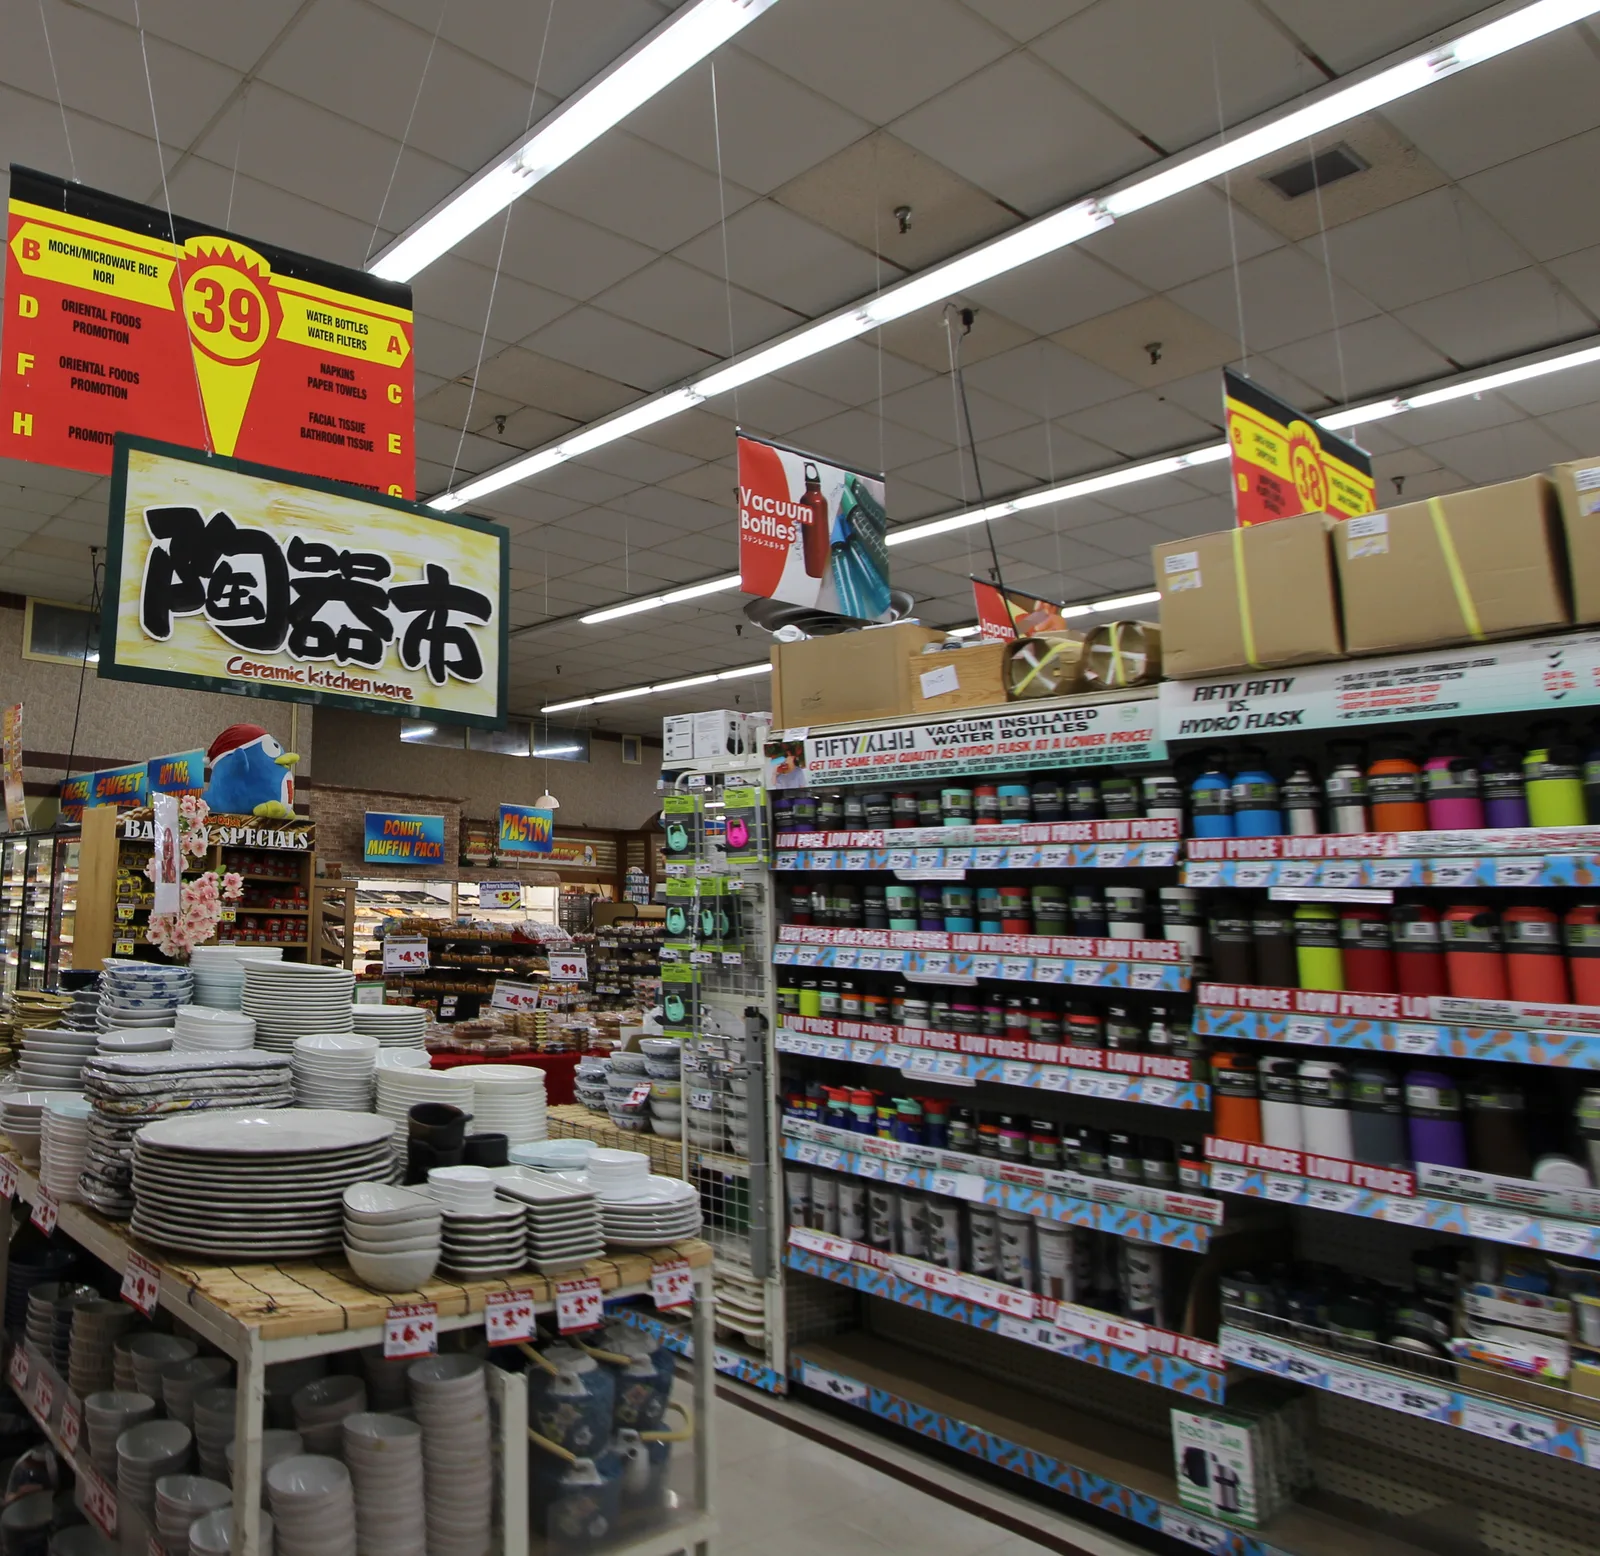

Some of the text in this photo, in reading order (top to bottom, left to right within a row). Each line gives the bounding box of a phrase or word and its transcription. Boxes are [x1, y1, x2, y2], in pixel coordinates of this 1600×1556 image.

[22, 238, 41, 261] B
[48, 239, 158, 279] MOCHI/MICROWAVE RICE
[92, 269, 115, 285] NORI
[18, 294, 39, 319] D
[61, 299, 142, 330] ORIENTAL FOODS
[193, 277, 261, 343] 39
[72, 319, 130, 346] PROMOTION
[306, 309, 369, 336] WATER BOTTLES
[307, 326, 367, 352] WATER FILTERS
[387, 336, 402, 355] A
[17, 352, 35, 375] F
[59, 355, 140, 385] ORIENTAL FOODS
[320, 362, 356, 382] NAPKINS
[70, 375, 128, 401] PROMOTION
[307, 376, 367, 400] PAPER TOWELS
[387, 384, 402, 404] C
[12, 411, 33, 437] H
[308, 411, 366, 435] FACIAL TISSUE
[300, 427, 374, 453] BATHROOM TISSUE
[388, 434, 402, 454] E
[1296, 456, 1322, 508] 38
[741, 486, 813, 524] Vacuum
[742, 510, 796, 542] Bottles
[143, 507, 492, 684] 陶器市
[982, 618, 1015, 638] Japan
[226, 655, 304, 683] Ceramic
[1193, 677, 1295, 701] FIFTY FIFTY
[926, 709, 1098, 738] VACUUM INSULATED
[932, 722, 1088, 746] WATER BOTTLES
[1179, 709, 1304, 734] HYDRO FLASK
[809, 729, 1153, 771] GET THE SAME HIGH QUALITY AS HYDRO FLASK AT A LOWER PRICE!
[96, 772, 144, 798] SWEET
[159, 764, 172, 785] HOT
[219, 826, 308, 850] SPECIALS
[384, 819, 425, 840] DONUT,
[502, 813, 551, 843] PASTRY
[776, 834, 797, 848] LOW
[827, 832, 849, 847] LOW
[1022, 825, 1050, 842] LOW
[1052, 823, 1093, 841] PRICE
[1097, 822, 1129, 840] LOW
[1131, 820, 1177, 839] PRICE
[367, 840, 441, 858] MUFFIN PACK
[1201, 985, 1236, 1005] LOW
[1240, 989, 1289, 1010] PRICE
[1296, 992, 1337, 1013] LOW
[1340, 994, 1398, 1017] PRICE
[1060, 1046, 1102, 1067] PRICE
[1143, 1056, 1189, 1079] PRICE
[1205, 1136, 1244, 1162] LOW
[1247, 1143, 1302, 1173] PRICE
[1307, 1155, 1349, 1182] LOW
[1353, 1163, 1414, 1196] PRICE
